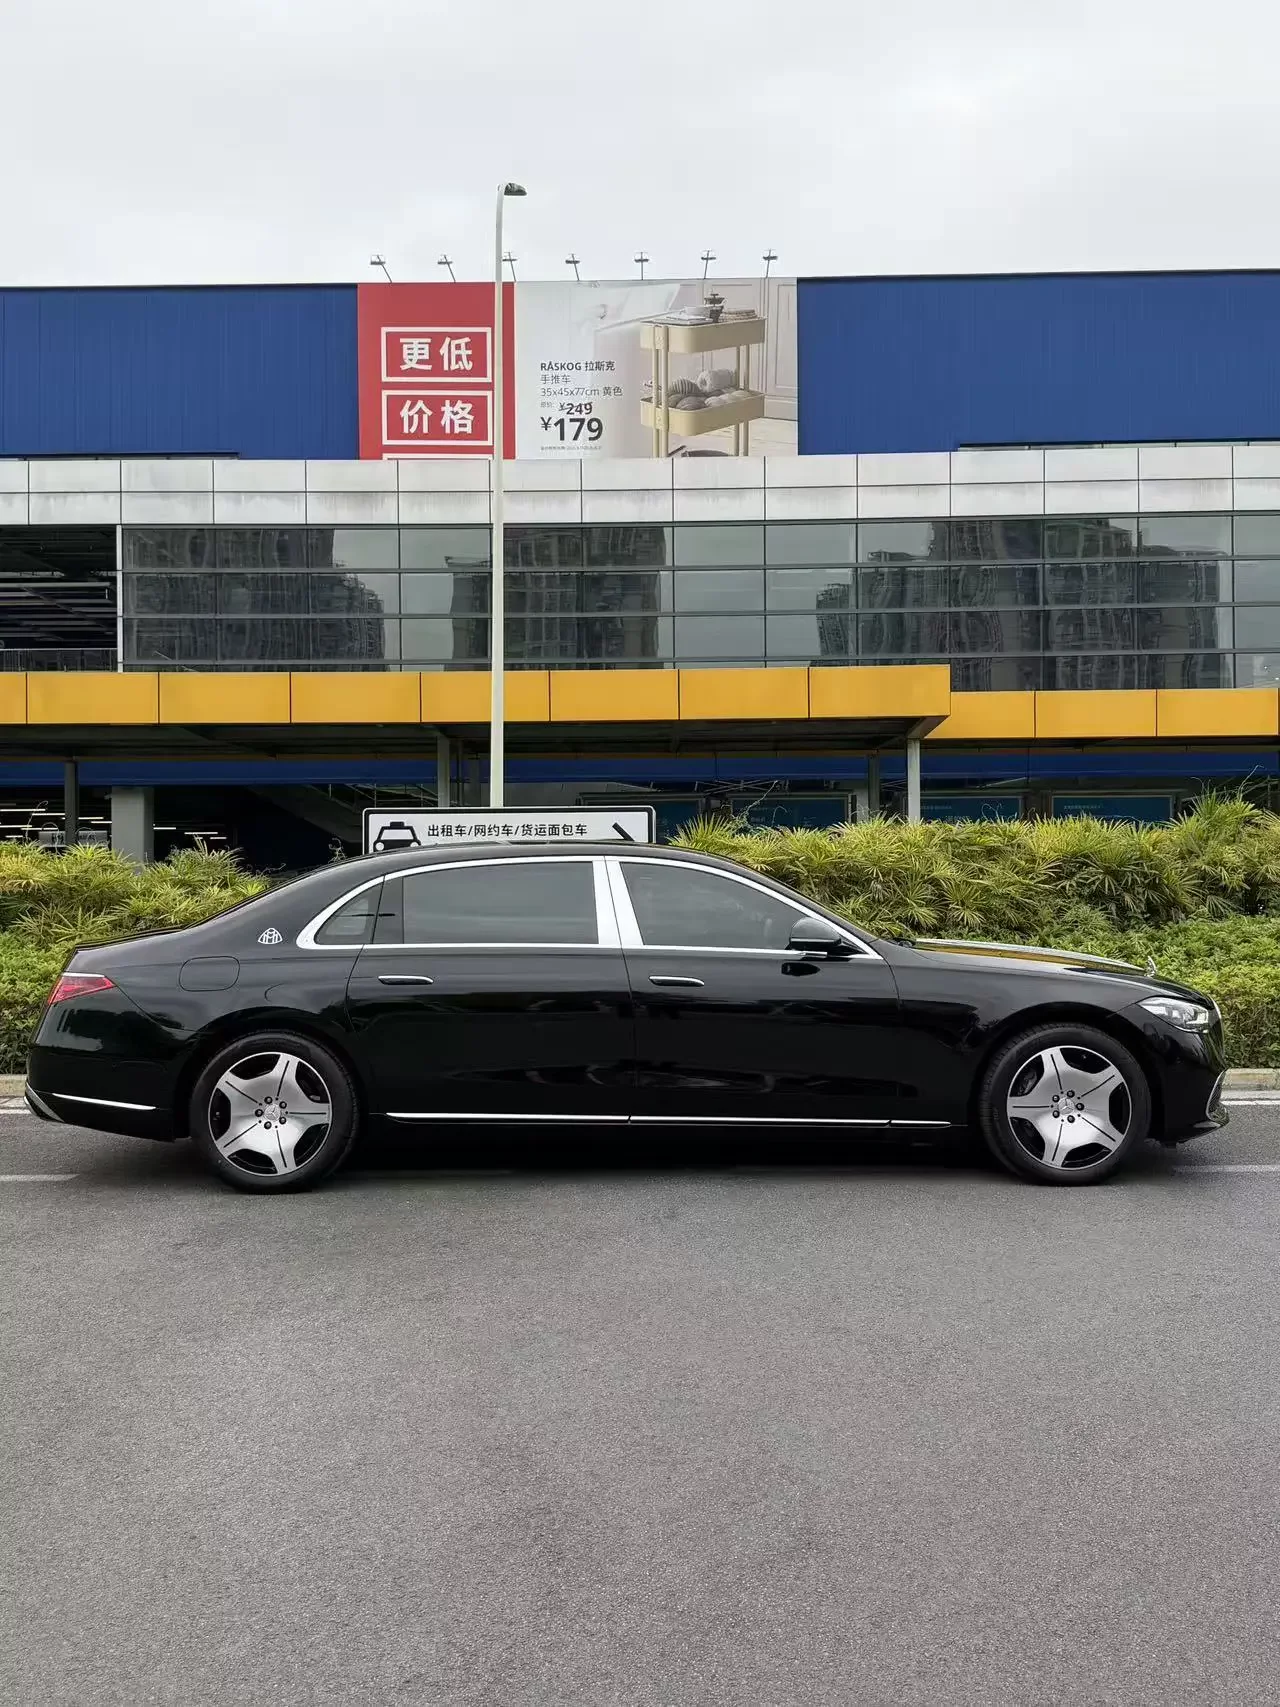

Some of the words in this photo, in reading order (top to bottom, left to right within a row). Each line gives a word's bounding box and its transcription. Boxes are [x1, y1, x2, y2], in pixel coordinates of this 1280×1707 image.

[400, 337, 473, 371] 更低
[540, 361, 582, 371] RÅSKOG
[585, 361, 616, 372] 拉斯克
[540, 374, 571, 385] 手推车
[540, 387, 600, 397] 35x45x77cm
[602, 386, 623, 397] 黄色
[400, 400, 475, 434] 价格
[540, 417, 603, 441] ¥179
[427, 823, 588, 838] 出租车/网约车/货运面包车
